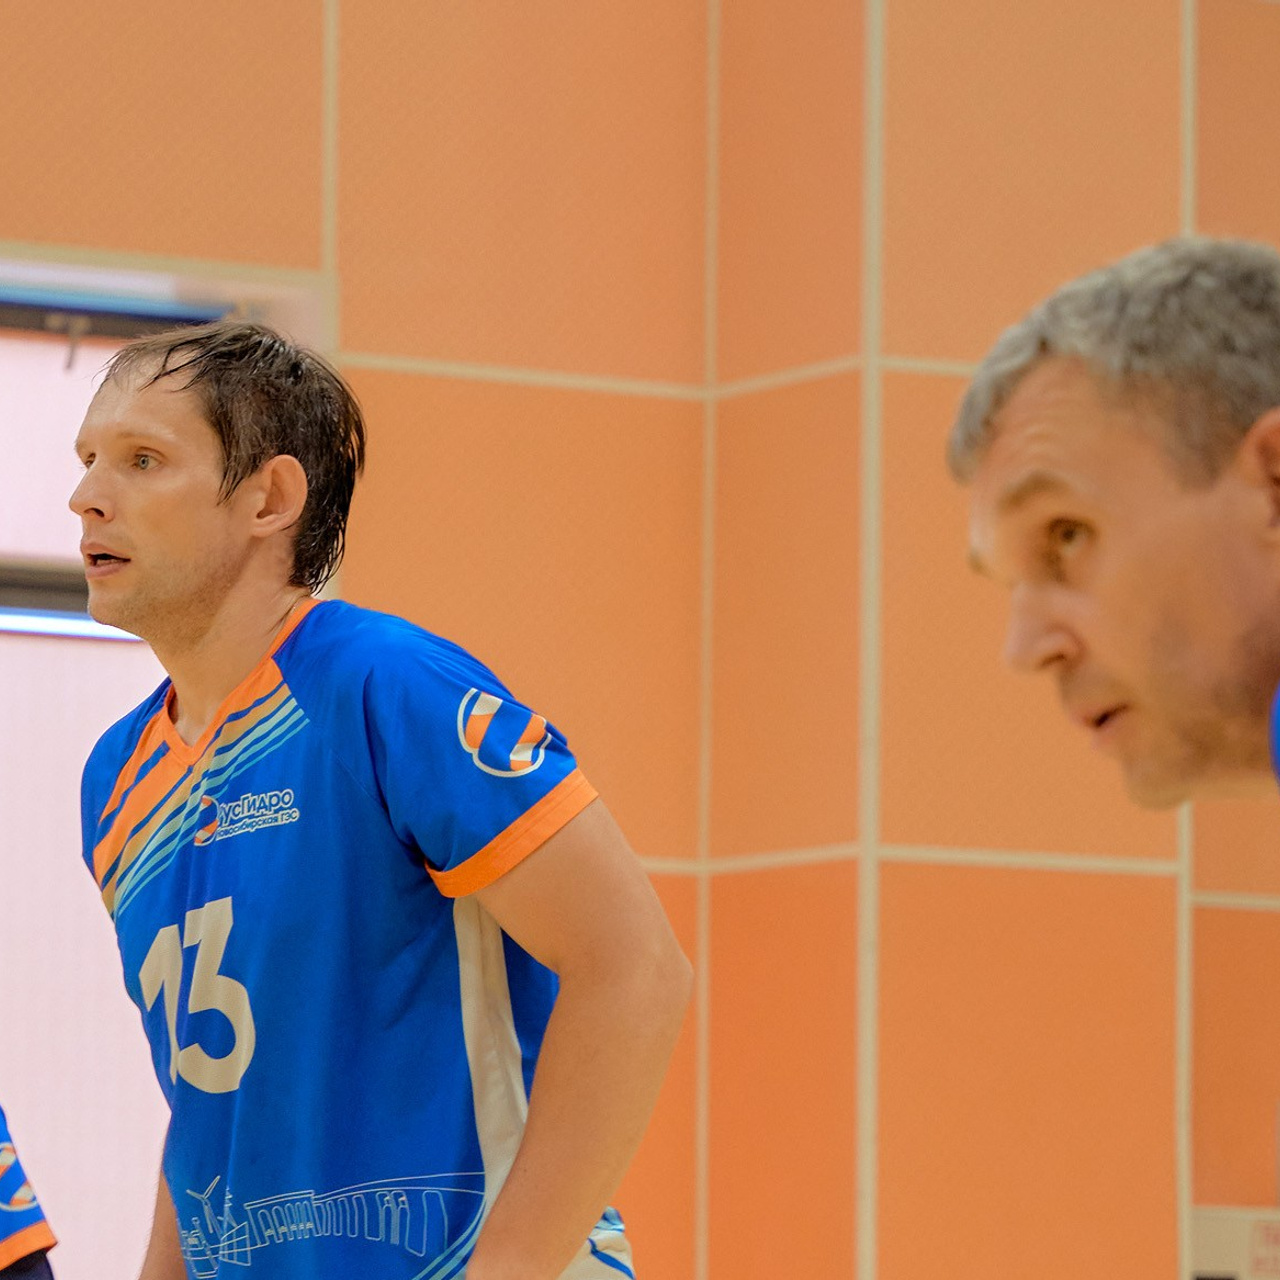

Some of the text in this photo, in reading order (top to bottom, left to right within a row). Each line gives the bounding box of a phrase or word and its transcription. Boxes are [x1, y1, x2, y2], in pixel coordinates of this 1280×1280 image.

[219, 789, 294, 827] усГидро
[217, 816, 279, 840] овосибирская
[138, 896, 256, 1094] 13
